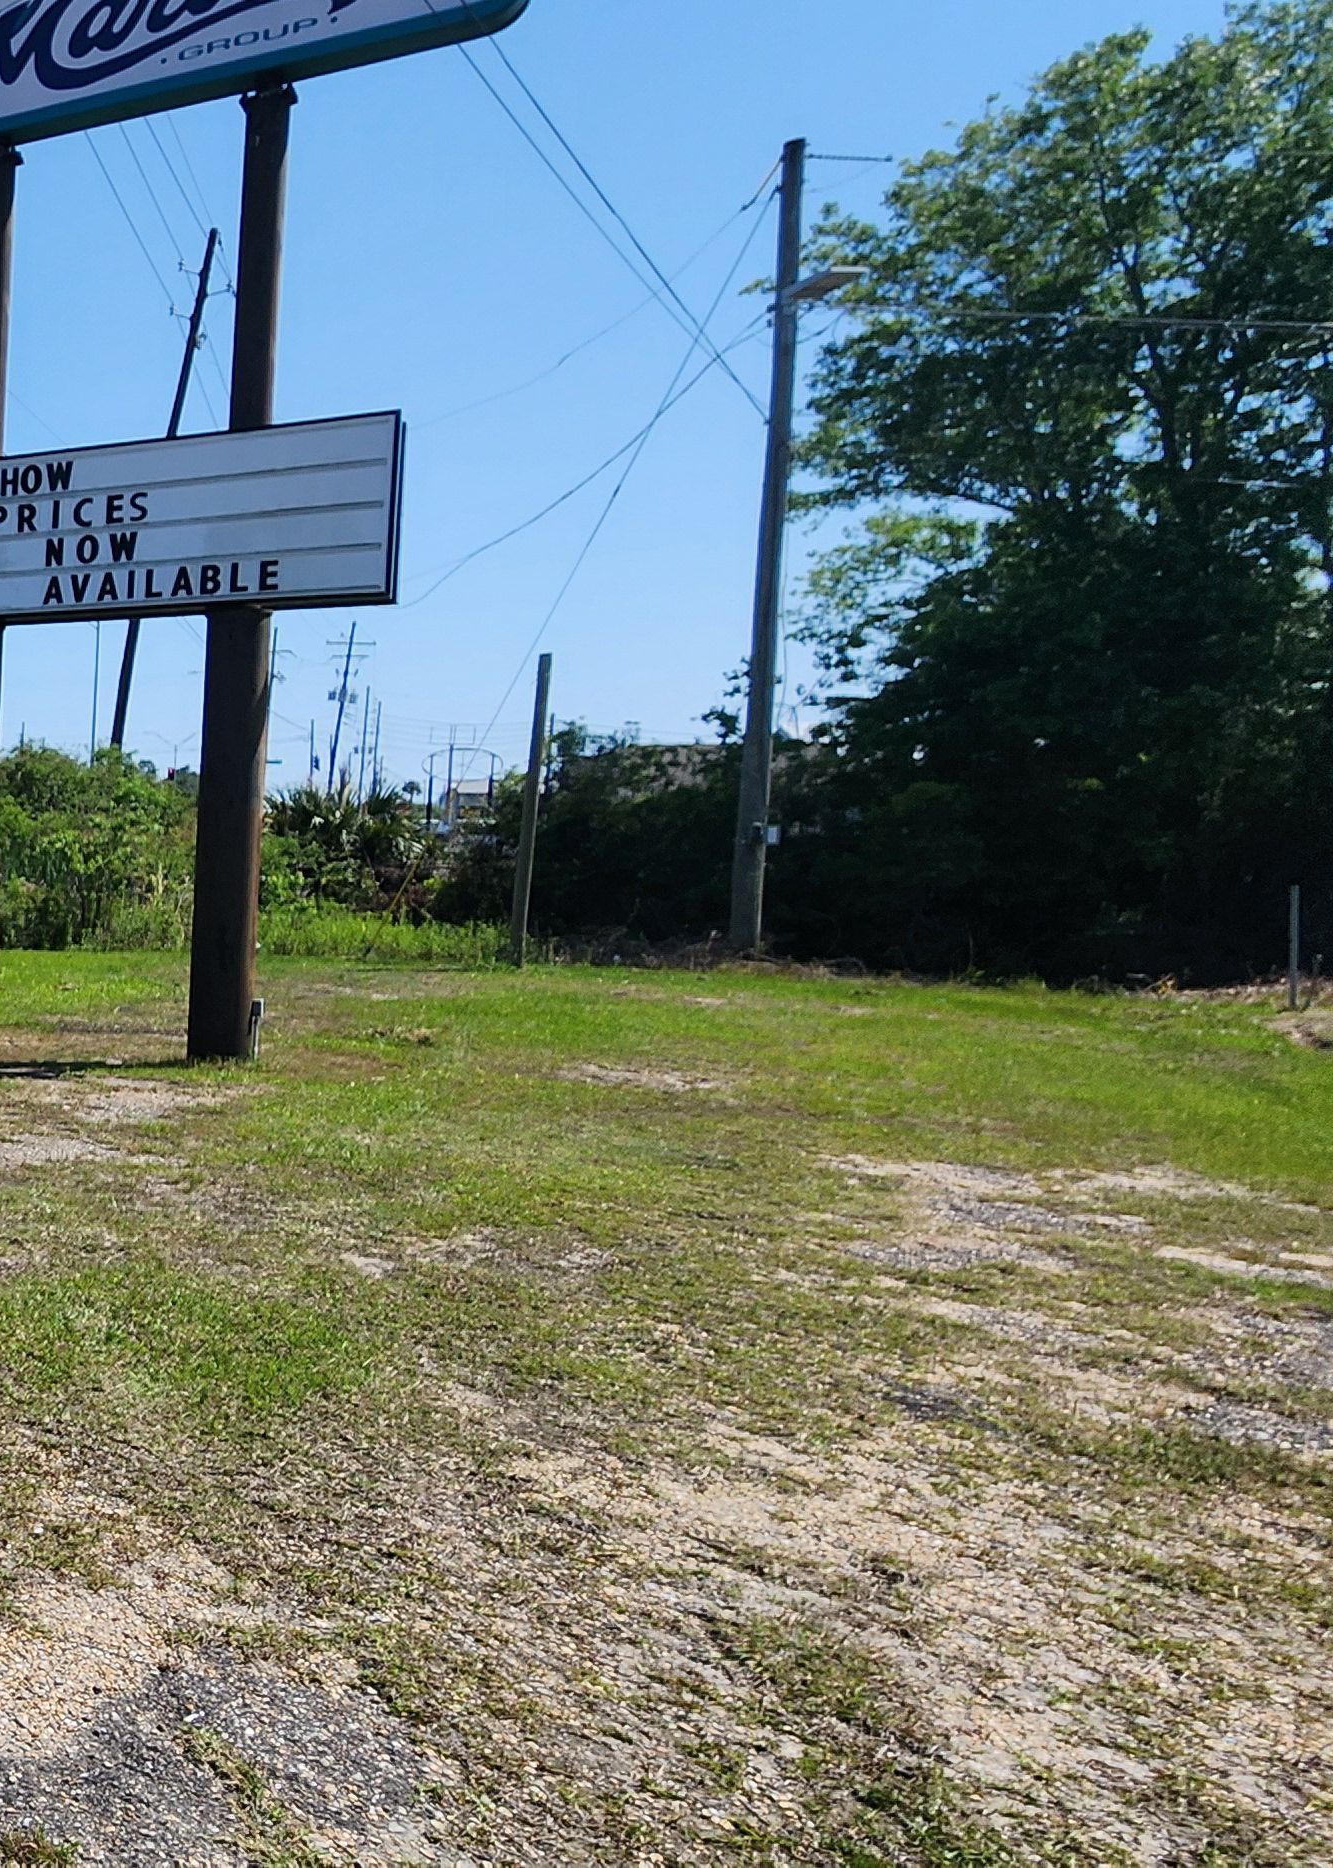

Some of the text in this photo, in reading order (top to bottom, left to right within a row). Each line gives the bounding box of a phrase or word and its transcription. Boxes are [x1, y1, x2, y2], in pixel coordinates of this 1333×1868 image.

[177, 17, 319, 62] GROUP
[44, 531, 139, 567] NOW
[42, 560, 279, 605] AVAILABLE
